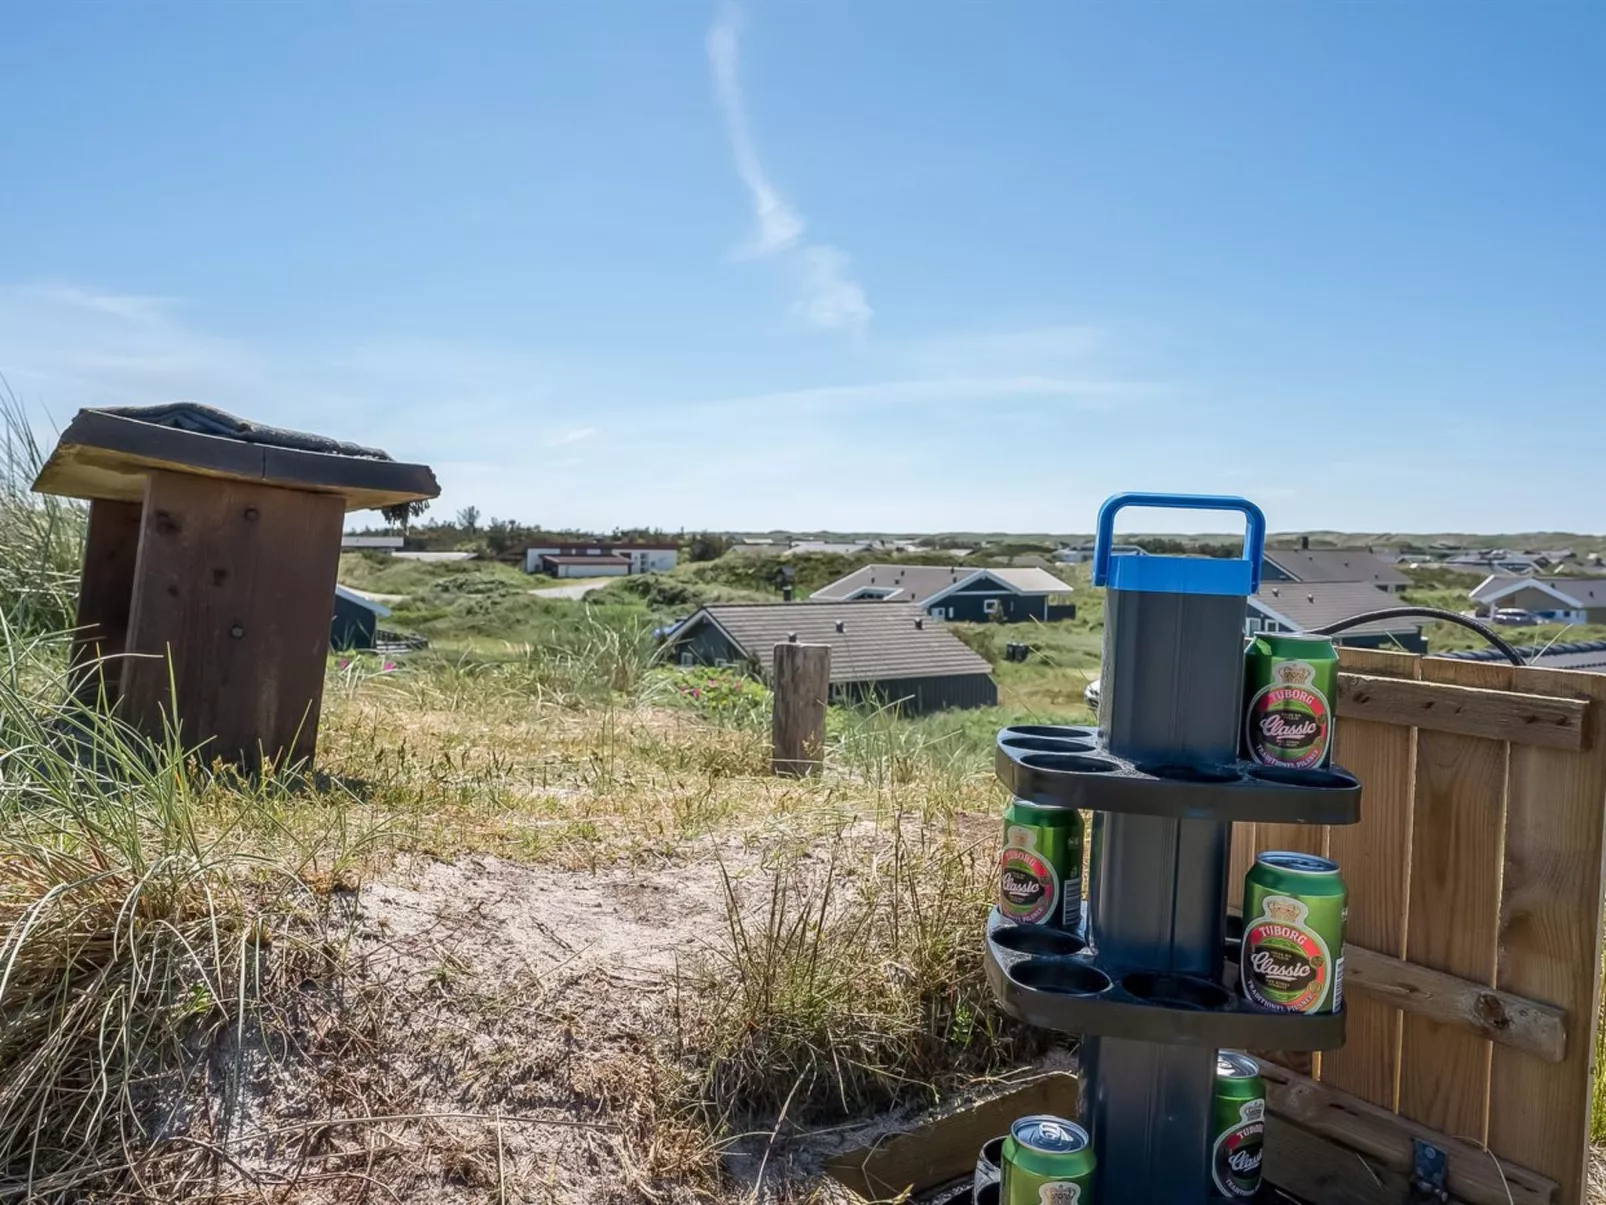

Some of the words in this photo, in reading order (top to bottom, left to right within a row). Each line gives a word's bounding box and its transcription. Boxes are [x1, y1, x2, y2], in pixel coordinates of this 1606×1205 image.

[1268, 689, 1315, 704] TUBORG
[1260, 714, 1317, 736] Classic
[1002, 872, 1040, 893] Classic
[1259, 925, 1307, 945] TUBORG
[1251, 951, 1311, 977] Classic
